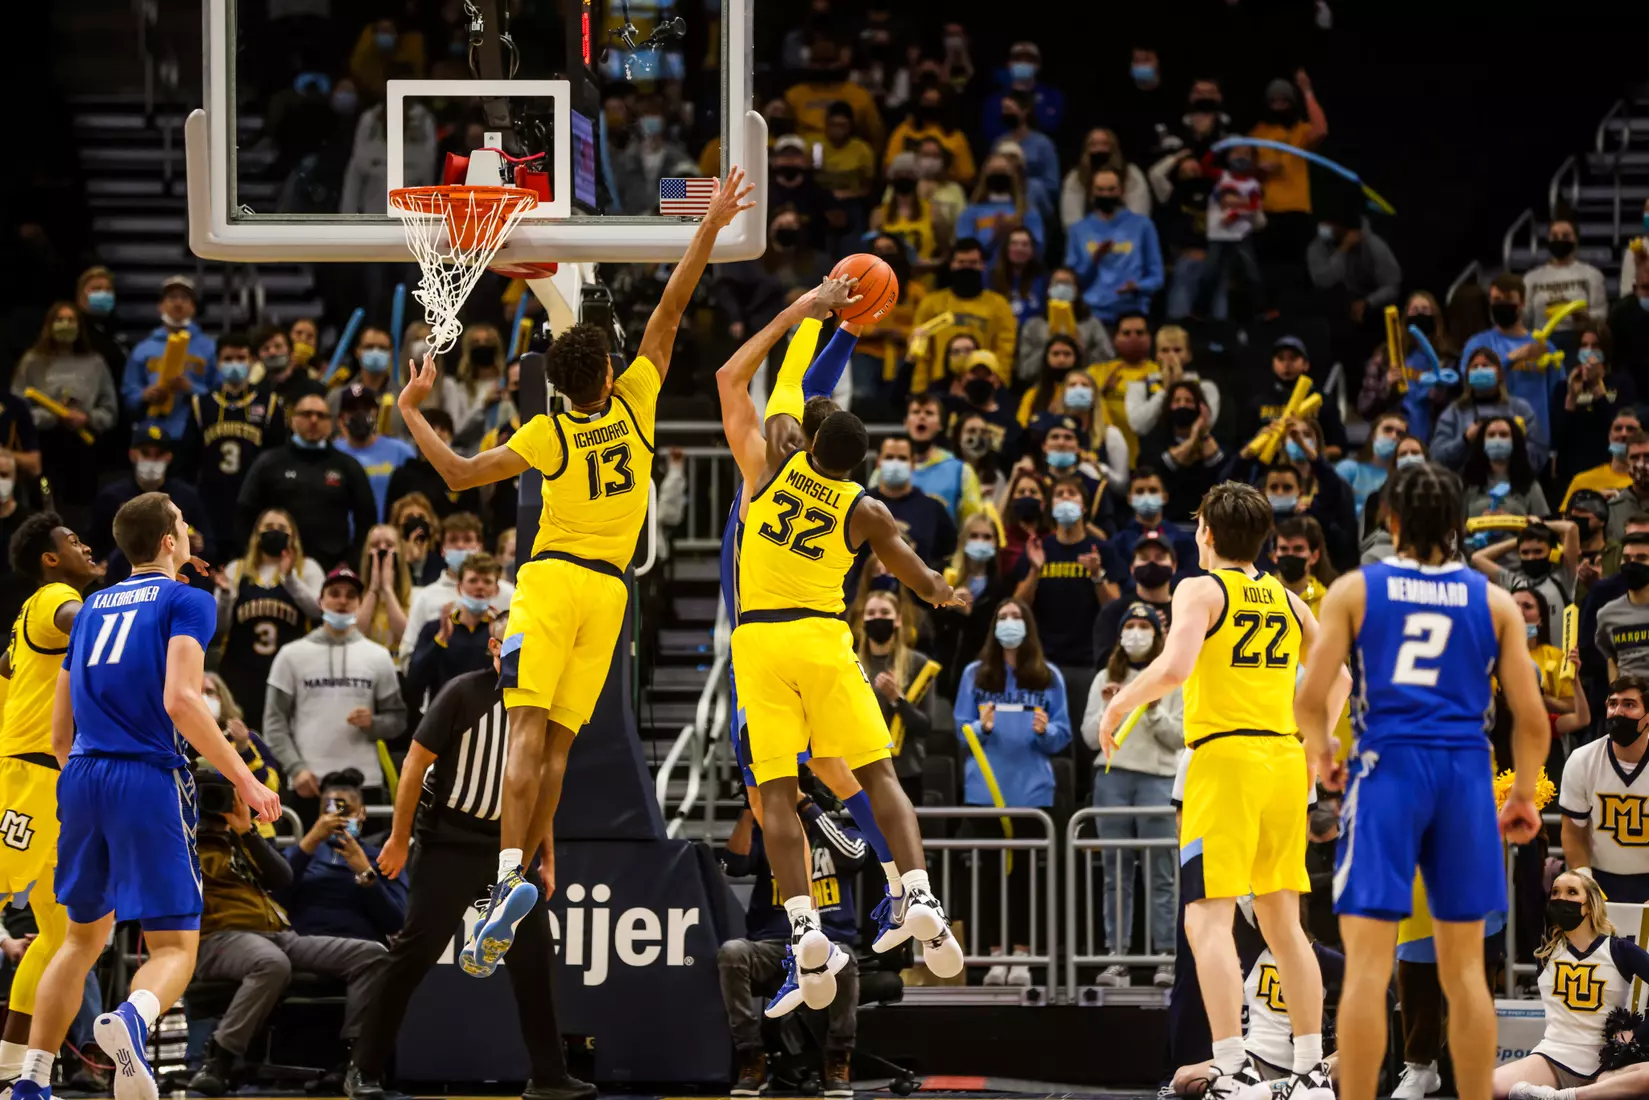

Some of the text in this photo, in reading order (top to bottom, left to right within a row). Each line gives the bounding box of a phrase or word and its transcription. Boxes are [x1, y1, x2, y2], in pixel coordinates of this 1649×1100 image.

[573, 420, 629, 449] IGHODARO
[219, 440, 241, 474] 3
[585, 442, 636, 500] 13
[785, 469, 841, 509] MORSELL
[758, 490, 837, 561] 32
[92, 585, 160, 609] KALKBRENNER
[1243, 586, 1275, 604] KOLEK
[1387, 576, 1468, 607] NEMBHARD
[86, 609, 138, 667] 11
[252, 622, 278, 656] 3
[1230, 609, 1290, 668] 22
[1391, 612, 1453, 687] 2
[1552, 959, 1608, 1012] MU
